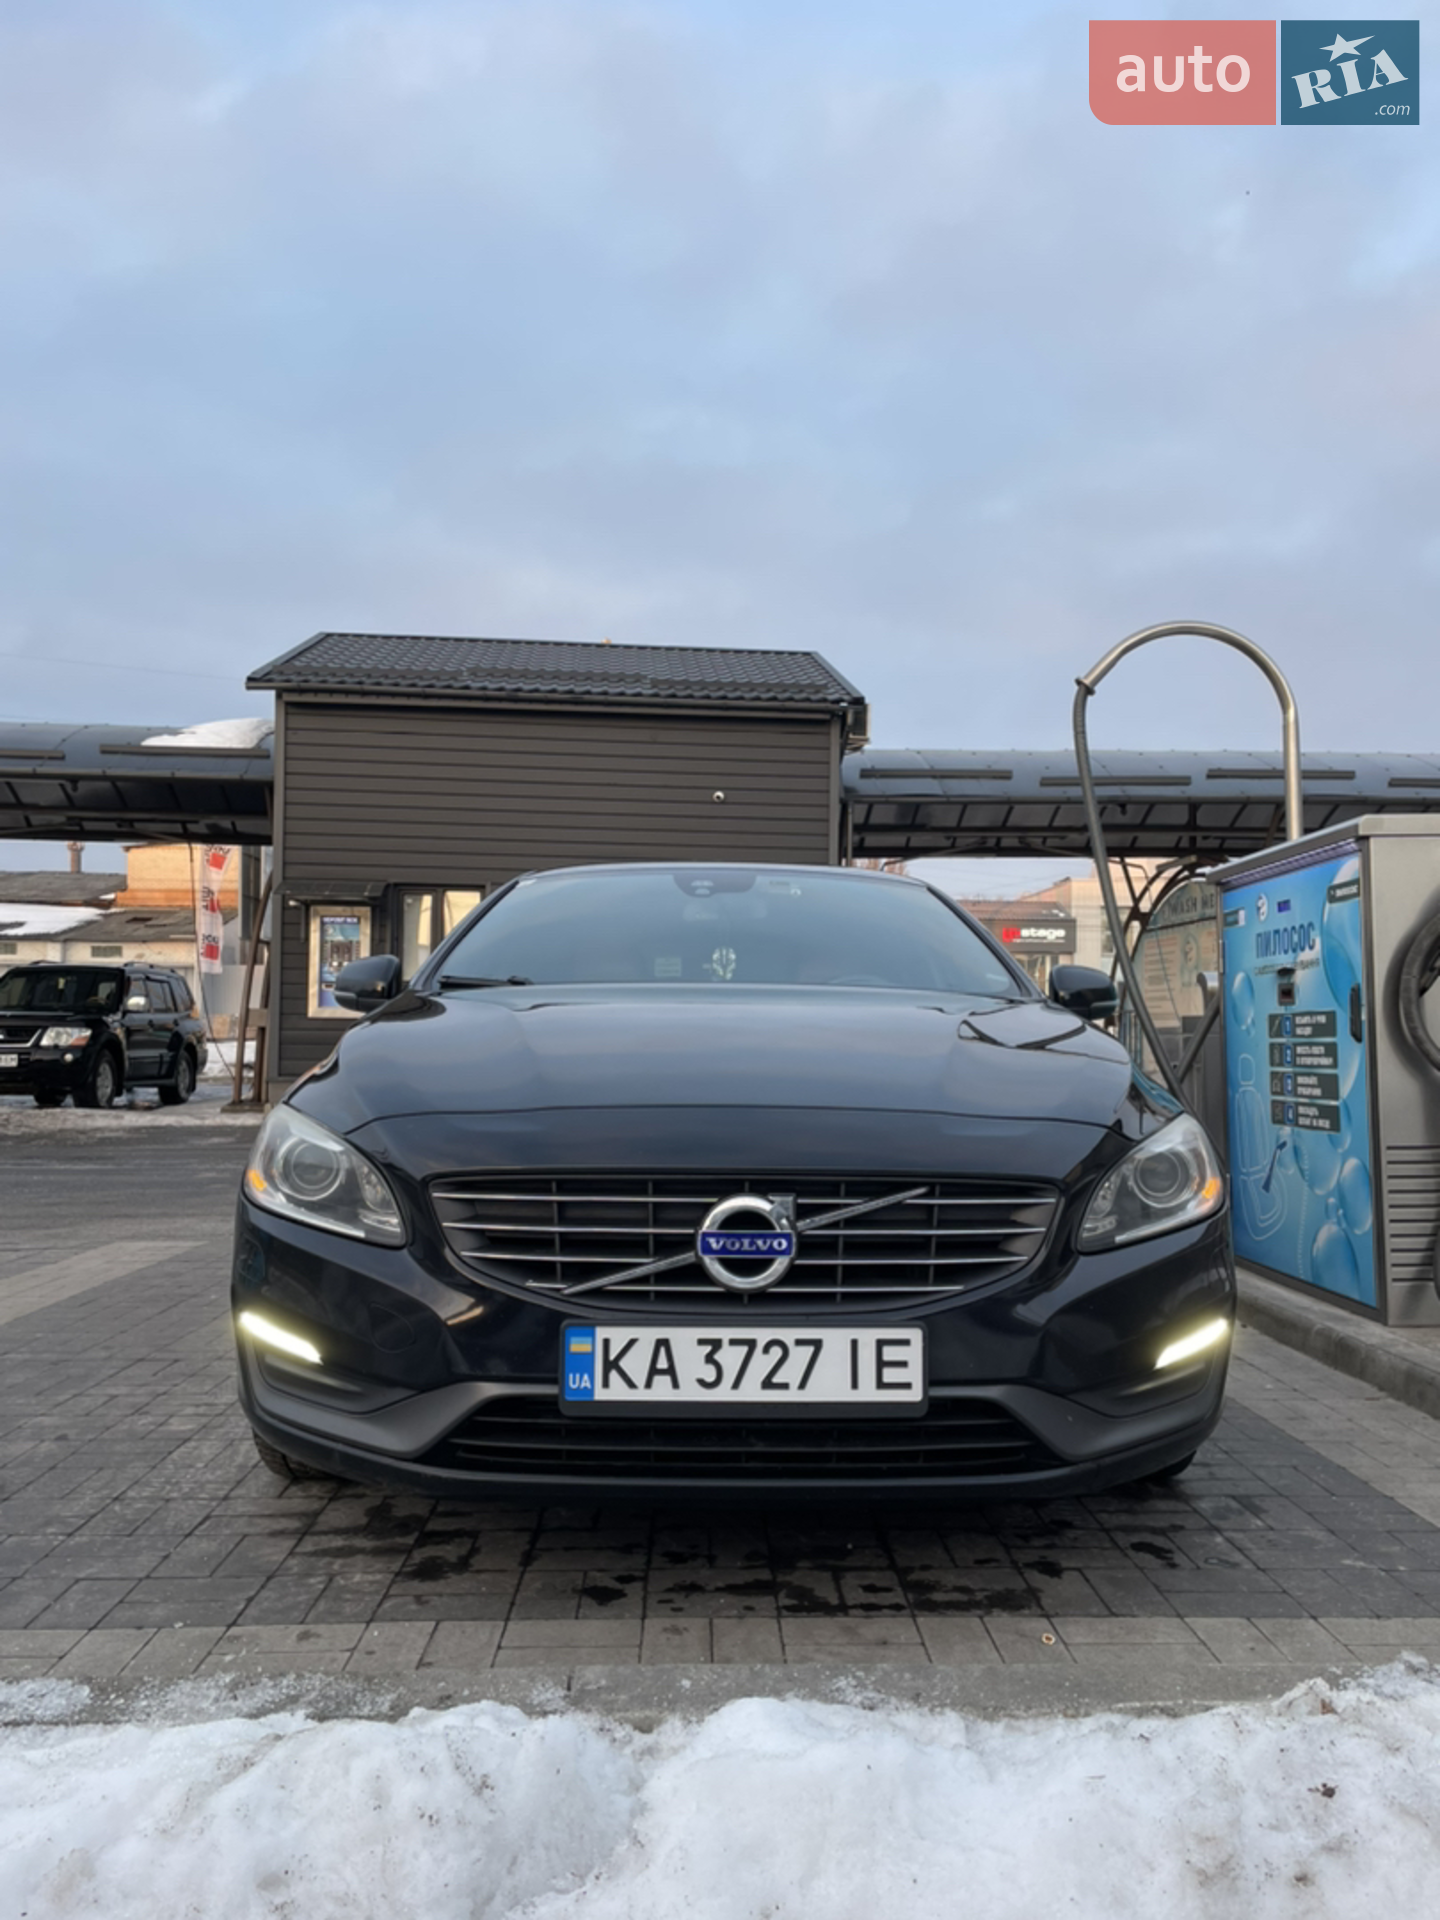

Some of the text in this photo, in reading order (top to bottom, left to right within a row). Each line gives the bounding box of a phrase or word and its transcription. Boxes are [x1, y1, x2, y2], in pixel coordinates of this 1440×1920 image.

[1255, 921, 1317, 959] ПИЛОСОС
[705, 1236, 788, 1252] VOLVO
[601, 1337, 913, 1391] KA 3727 IE
[568, 1373, 592, 1390] UA
